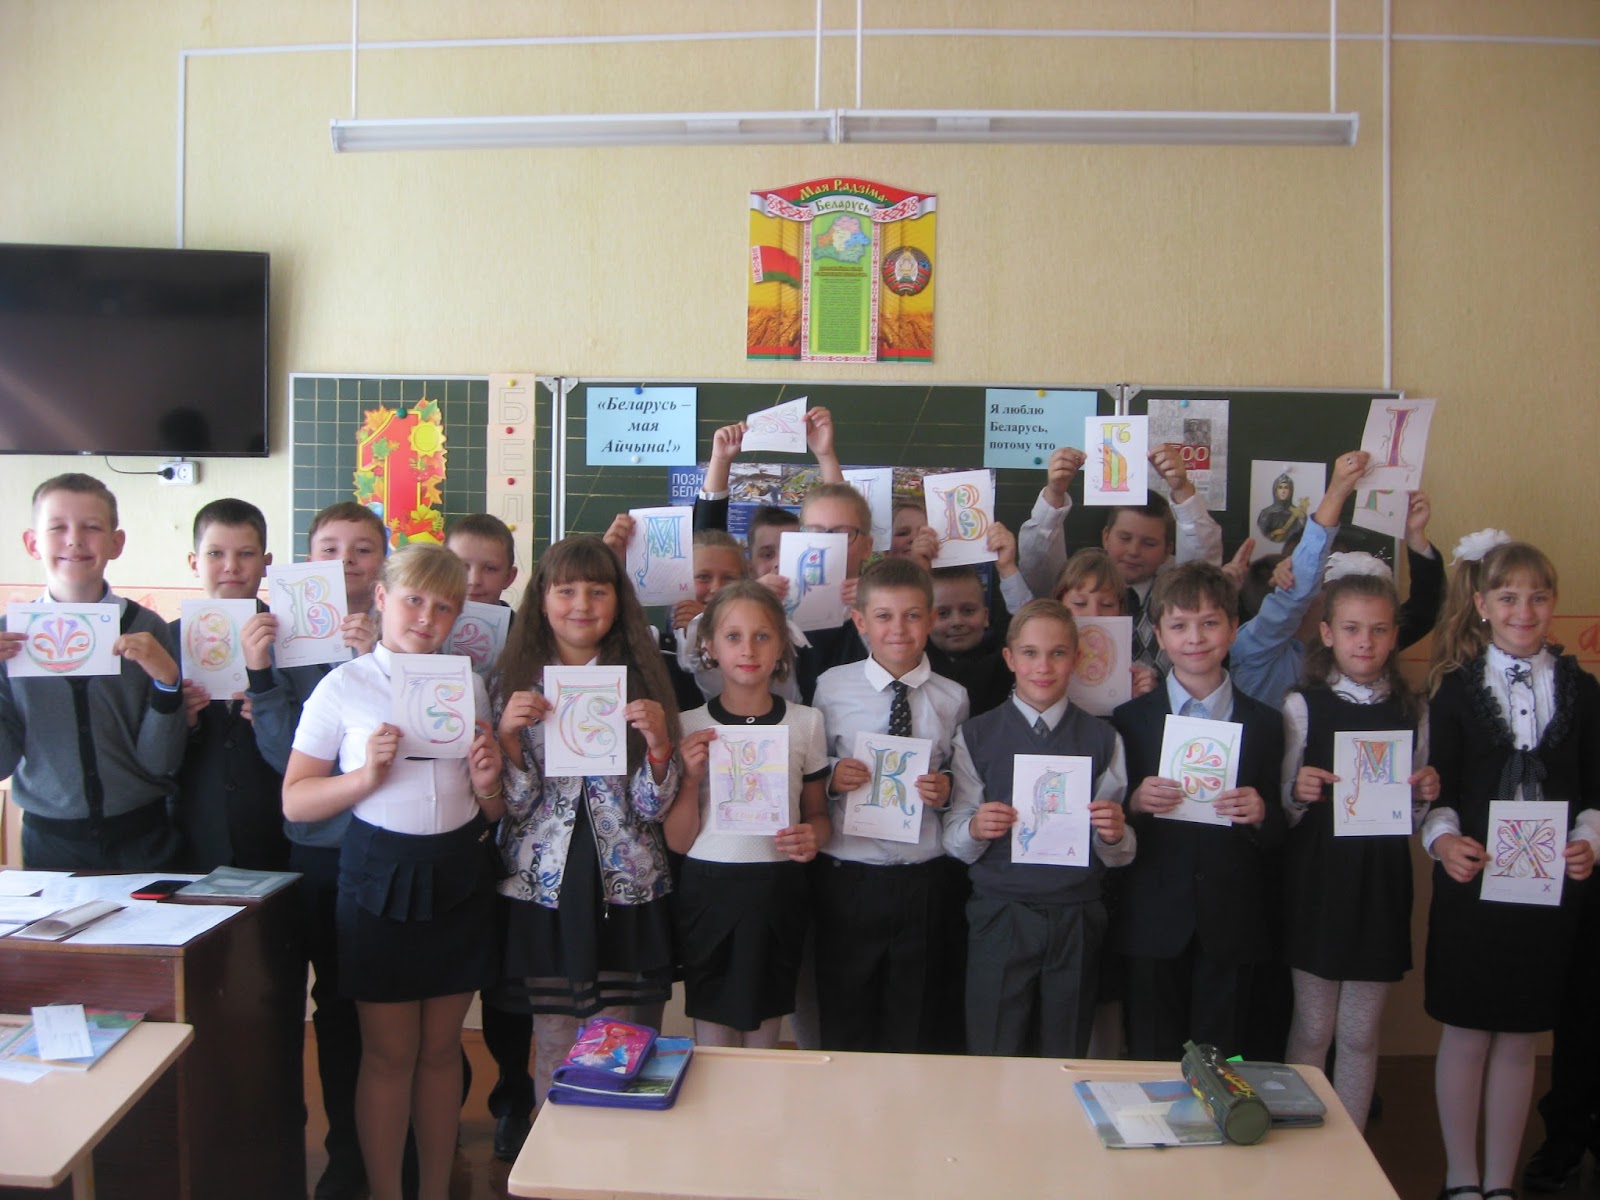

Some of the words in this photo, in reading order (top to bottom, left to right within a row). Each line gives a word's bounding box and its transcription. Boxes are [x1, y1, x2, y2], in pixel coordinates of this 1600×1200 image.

[800, 183, 829, 200] Мая
[815, 200, 870, 213] Беларусь
[597, 396, 676, 414] «Беларусь
[990, 404, 999, 414] Я
[1002, 404, 1044, 414] люблю
[627, 421, 660, 432] мая
[990, 421, 1048, 434] Беларусь,
[601, 439, 681, 453] Айчына!»
[989, 441, 1031, 452] потому
[1035, 442, 1056, 451] что
